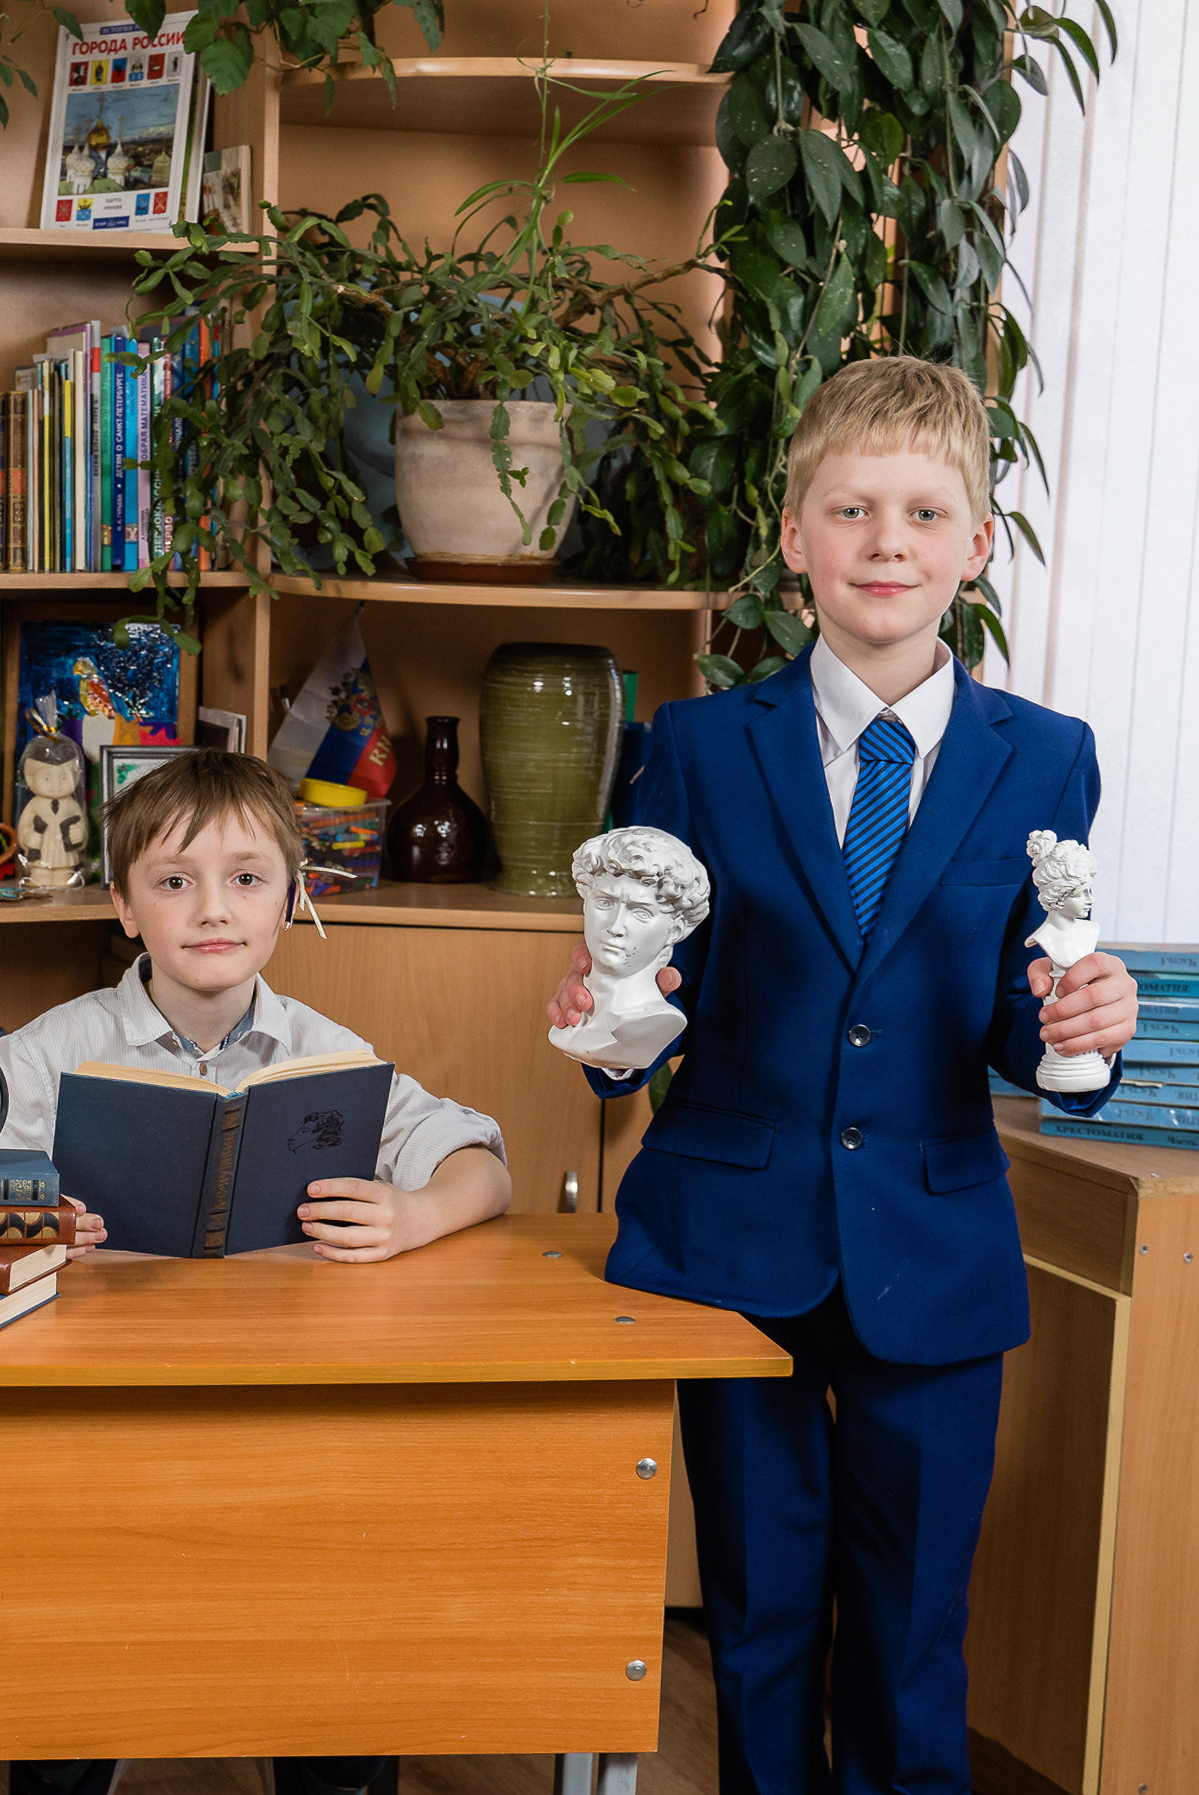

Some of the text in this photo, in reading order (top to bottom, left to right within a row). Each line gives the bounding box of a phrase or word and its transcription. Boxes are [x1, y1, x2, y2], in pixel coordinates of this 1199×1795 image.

[71, 38, 128, 57] ГОРОДА
[115, 373, 124, 442] САНКТ-ПЕТЕРБУРГЕ
[141, 372, 149, 430] МАТЕМАТИКА
[116, 444, 124, 452] О
[115, 454, 124, 479] ДЕТЯМ
[1054, 1124, 1198, 1147] ХРЕСТОМАТИЯ Часть
